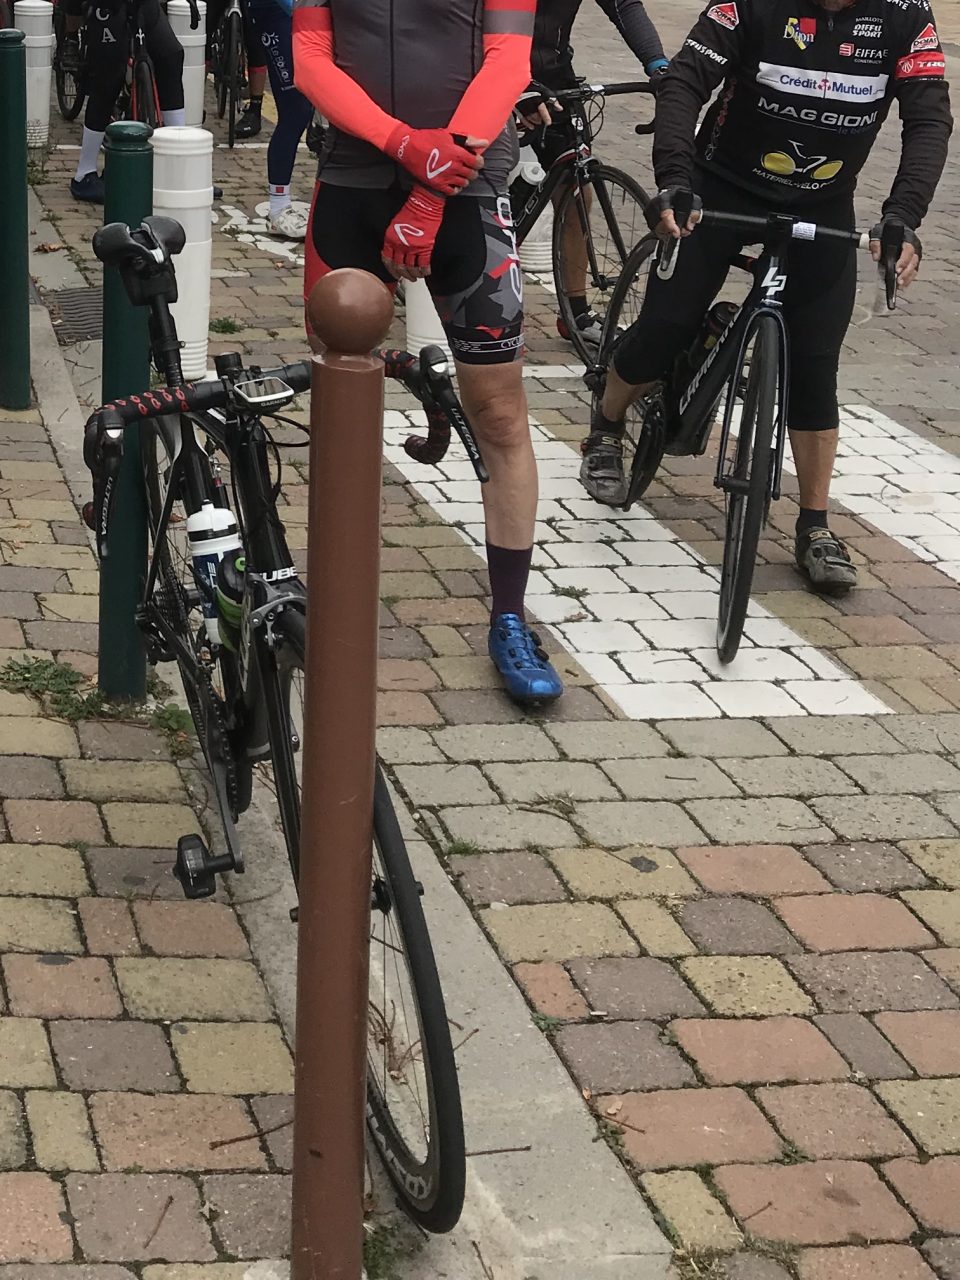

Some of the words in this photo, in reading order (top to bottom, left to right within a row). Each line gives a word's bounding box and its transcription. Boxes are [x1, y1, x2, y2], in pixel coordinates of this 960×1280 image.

[852, 30, 882, 38] SPORT
[780, 75, 817, 90] Crédit
[831, 80, 873, 96] Mutuel
[758, 96, 878, 127] MAGGIONI
[260, 397, 288, 408] GARMIN
[262, 566, 298, 582] UBE
